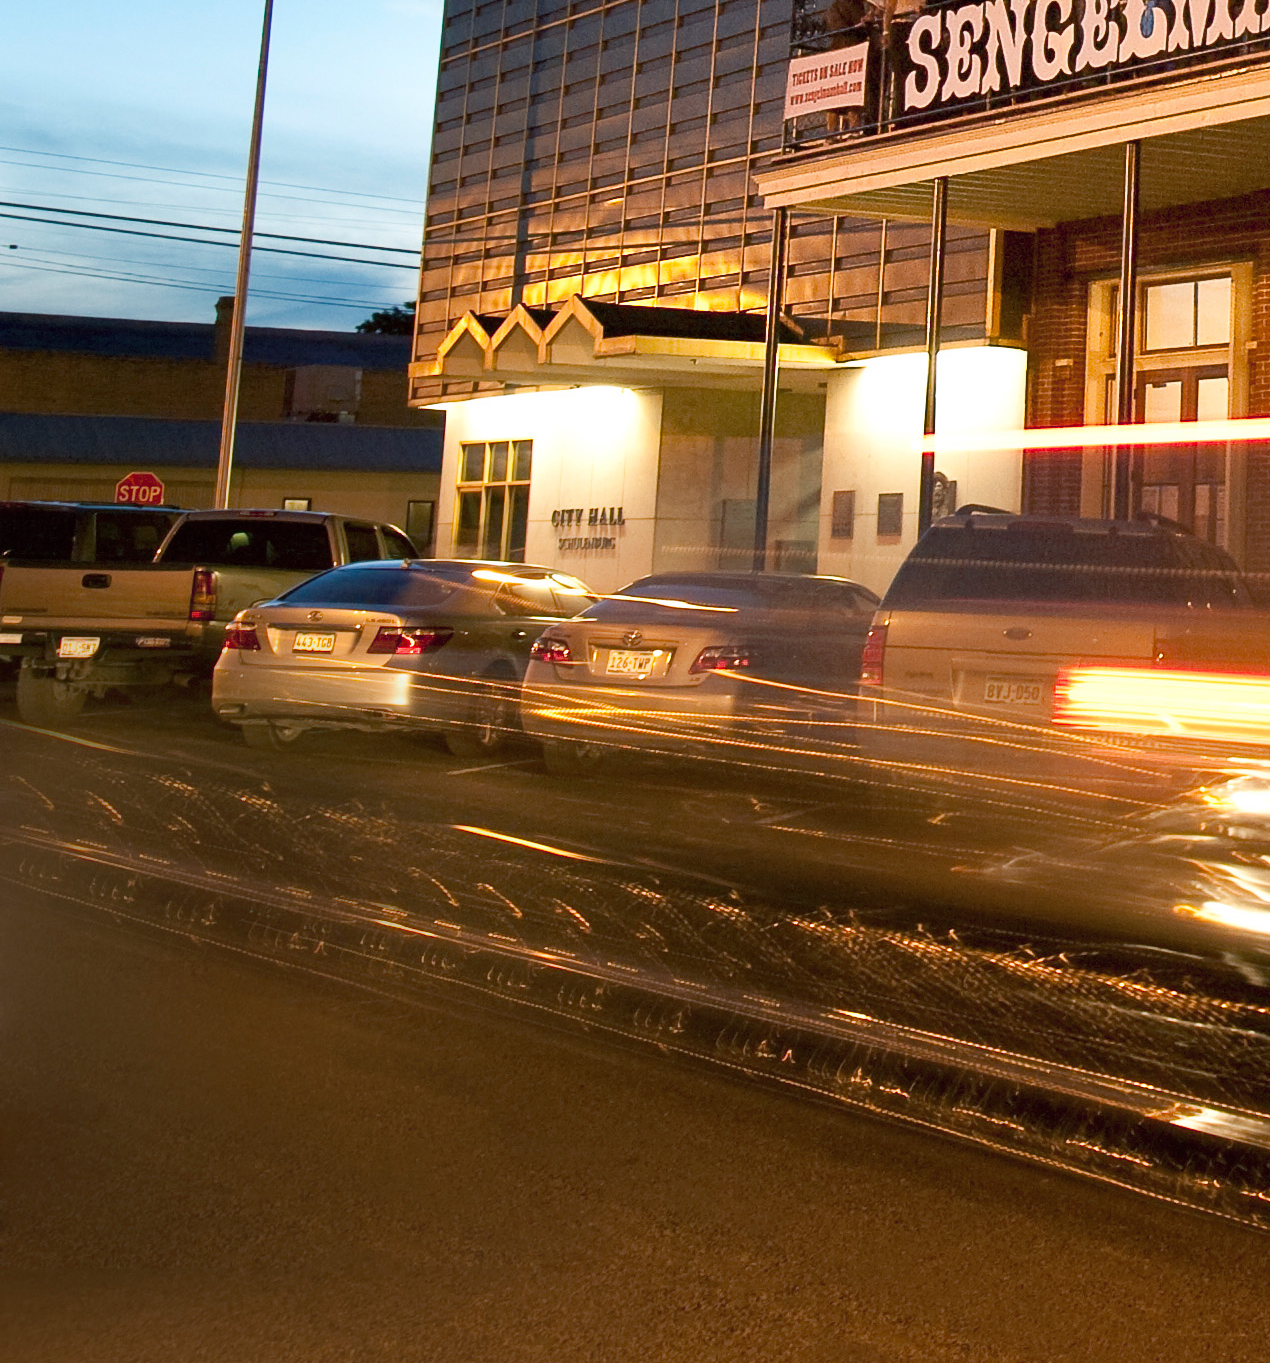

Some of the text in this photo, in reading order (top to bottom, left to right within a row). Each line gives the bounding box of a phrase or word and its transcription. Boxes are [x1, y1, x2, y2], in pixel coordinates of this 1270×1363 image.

[792, 57, 863, 86] TICKETS ON SALE NOW
[118, 485, 160, 501] STOP
[551, 506, 625, 527] CITY HALL
